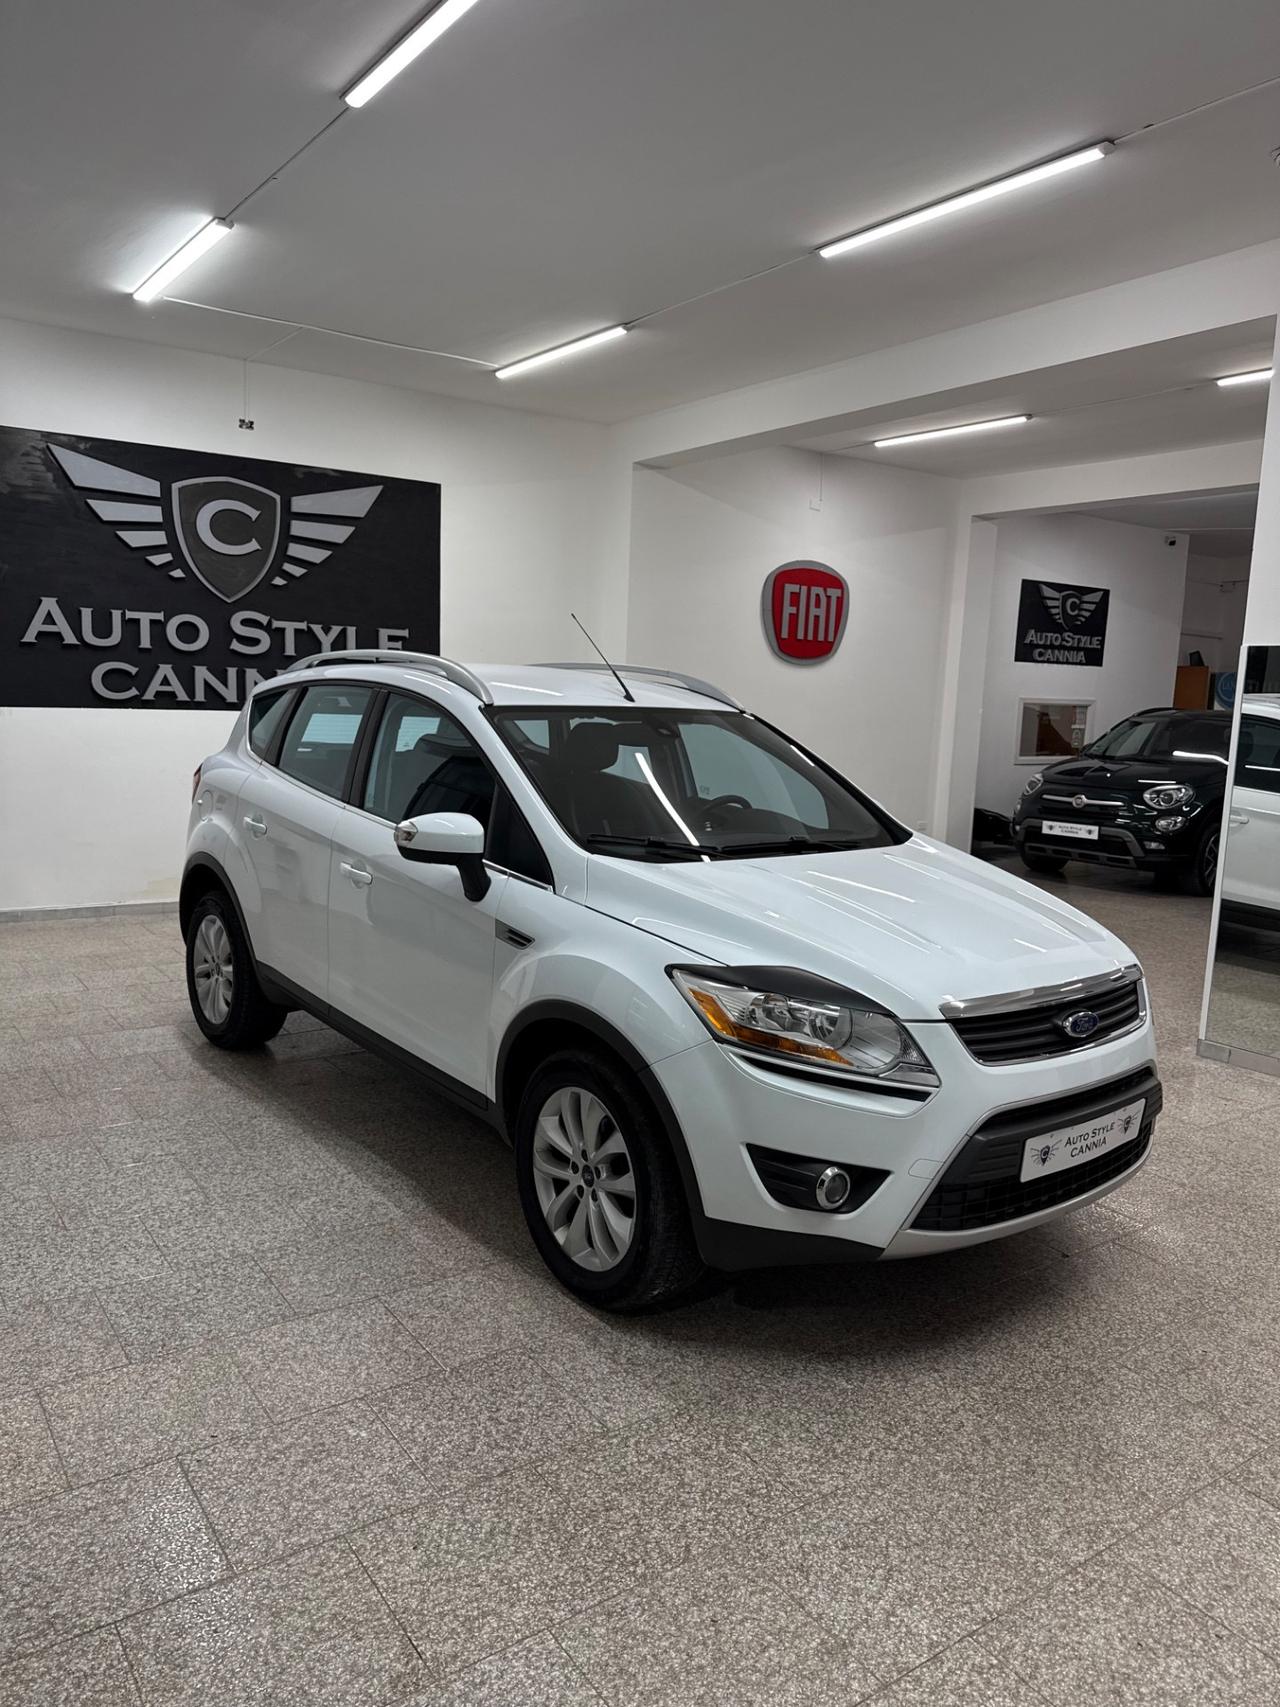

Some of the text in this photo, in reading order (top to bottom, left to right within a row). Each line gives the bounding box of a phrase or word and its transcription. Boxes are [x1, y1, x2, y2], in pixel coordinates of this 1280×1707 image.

[196, 499, 262, 555] C
[781, 583, 842, 642] FIAT
[1065, 598, 1080, 616] C
[20, 597, 210, 653] AUTO
[1023, 628, 1102, 648] AUTO STYLE
[1032, 648, 1086, 663] CANNIA
[1064, 1122, 1115, 1147] AUTO STYLE
[1070, 1136, 1107, 1158] CANNIA
